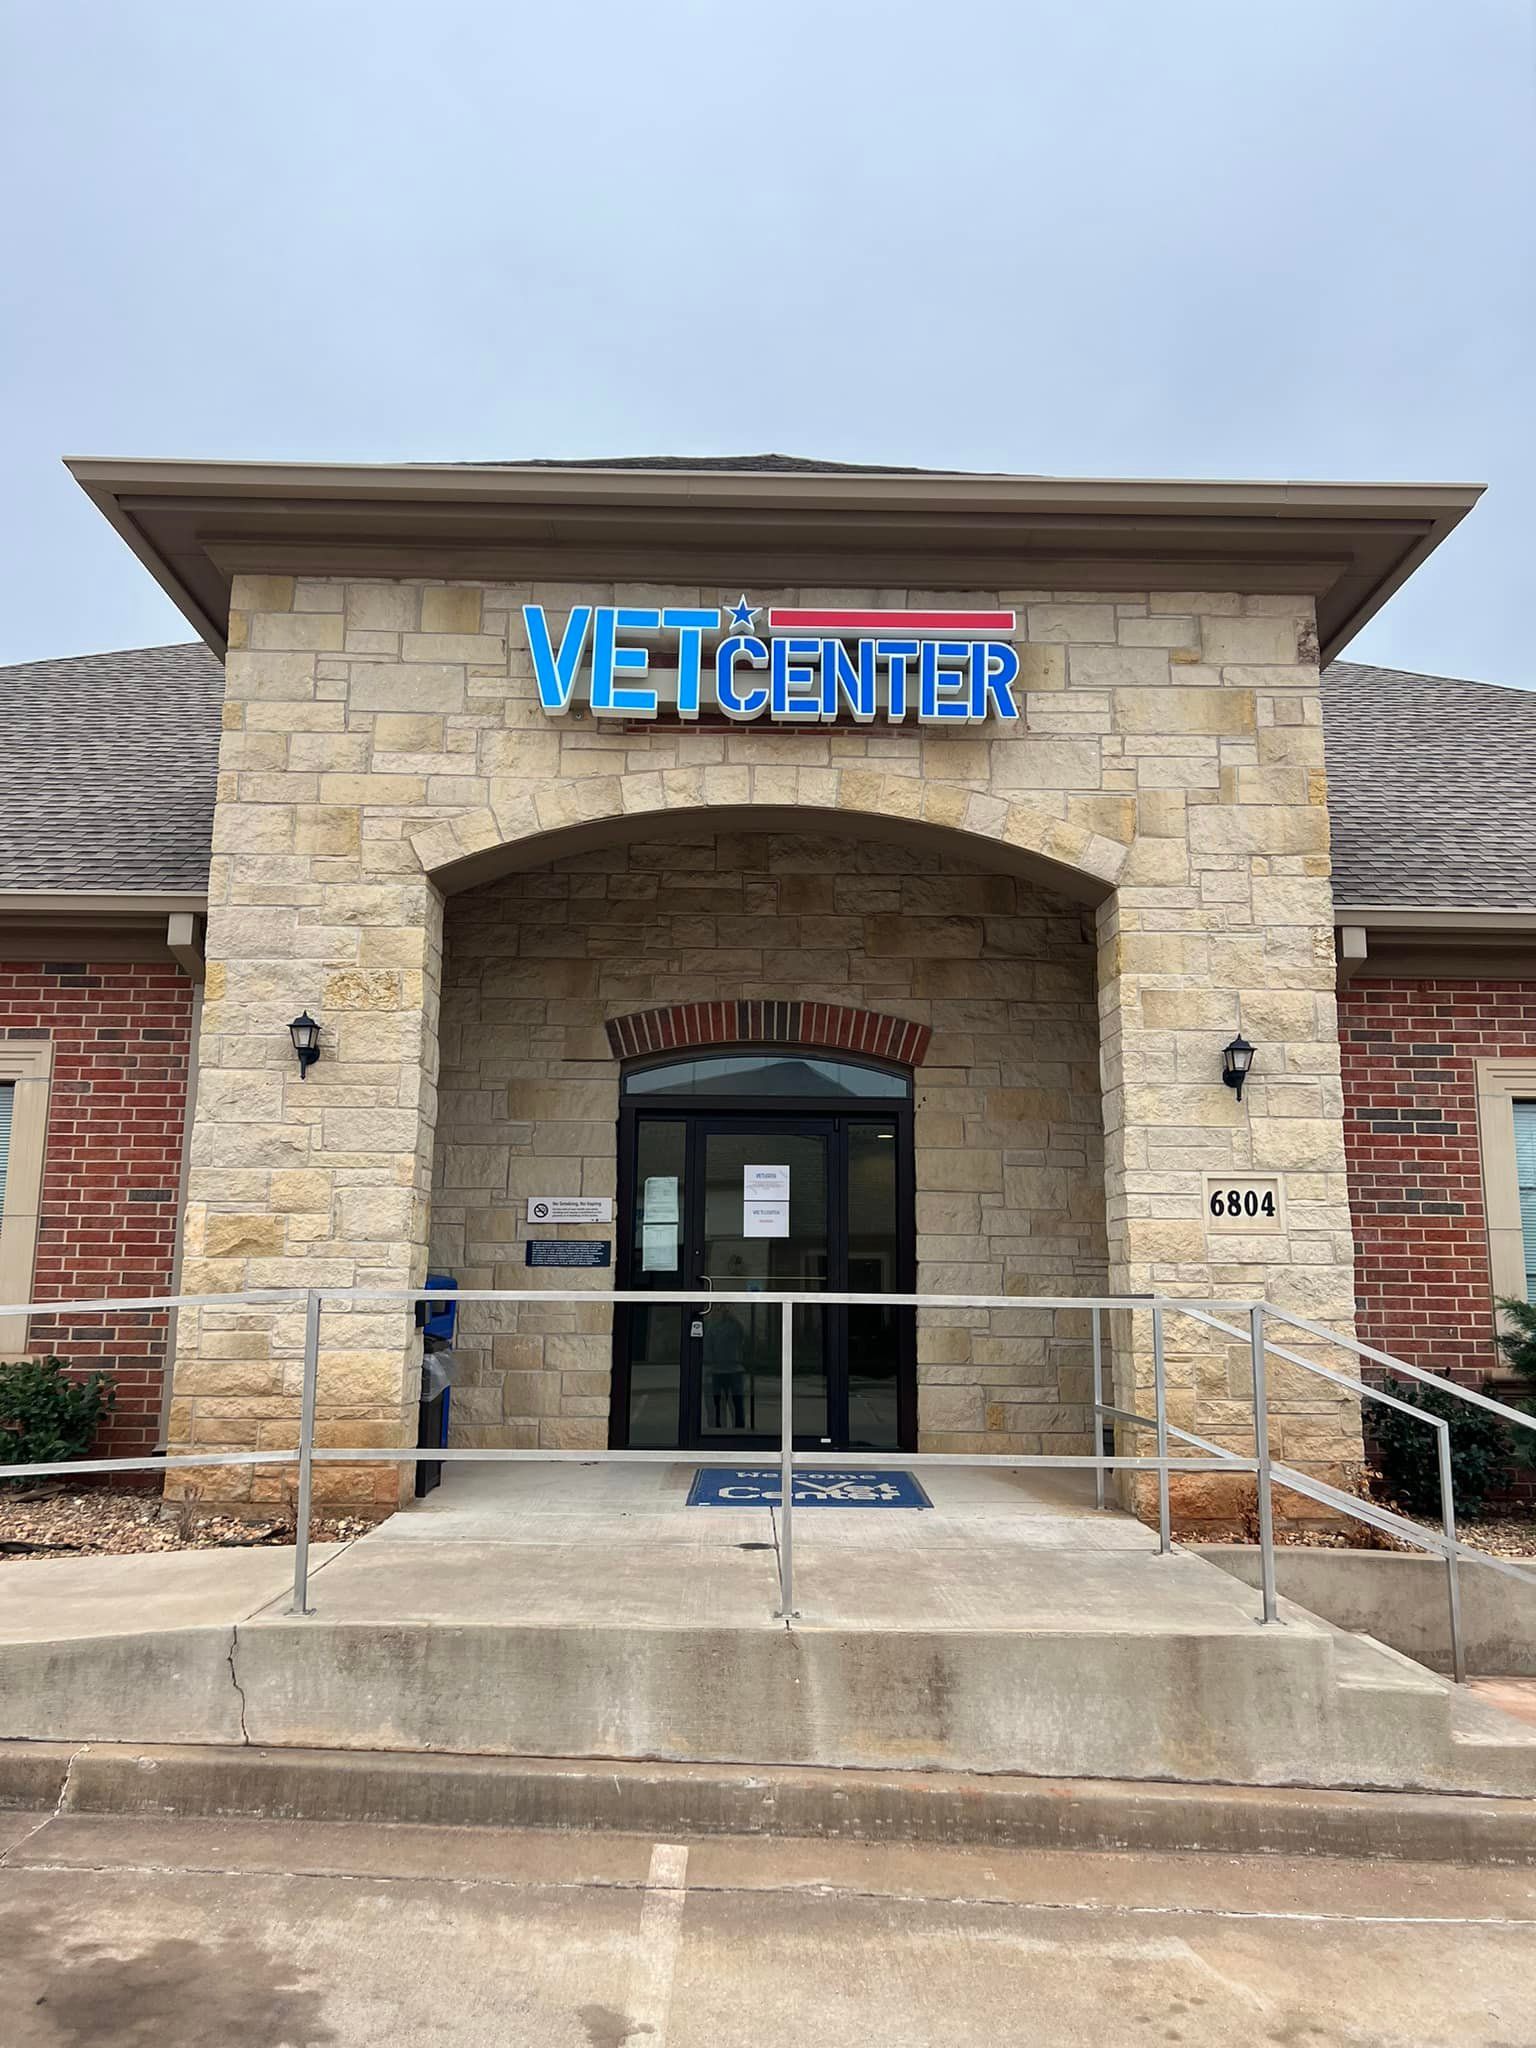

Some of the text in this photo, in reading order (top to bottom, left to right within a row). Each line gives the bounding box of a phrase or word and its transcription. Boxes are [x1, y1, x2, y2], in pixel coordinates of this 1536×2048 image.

[522, 605, 1020, 719] VET CENTER
[1210, 1190, 1276, 1217] 6804
[735, 1471, 876, 1480] Wecome
